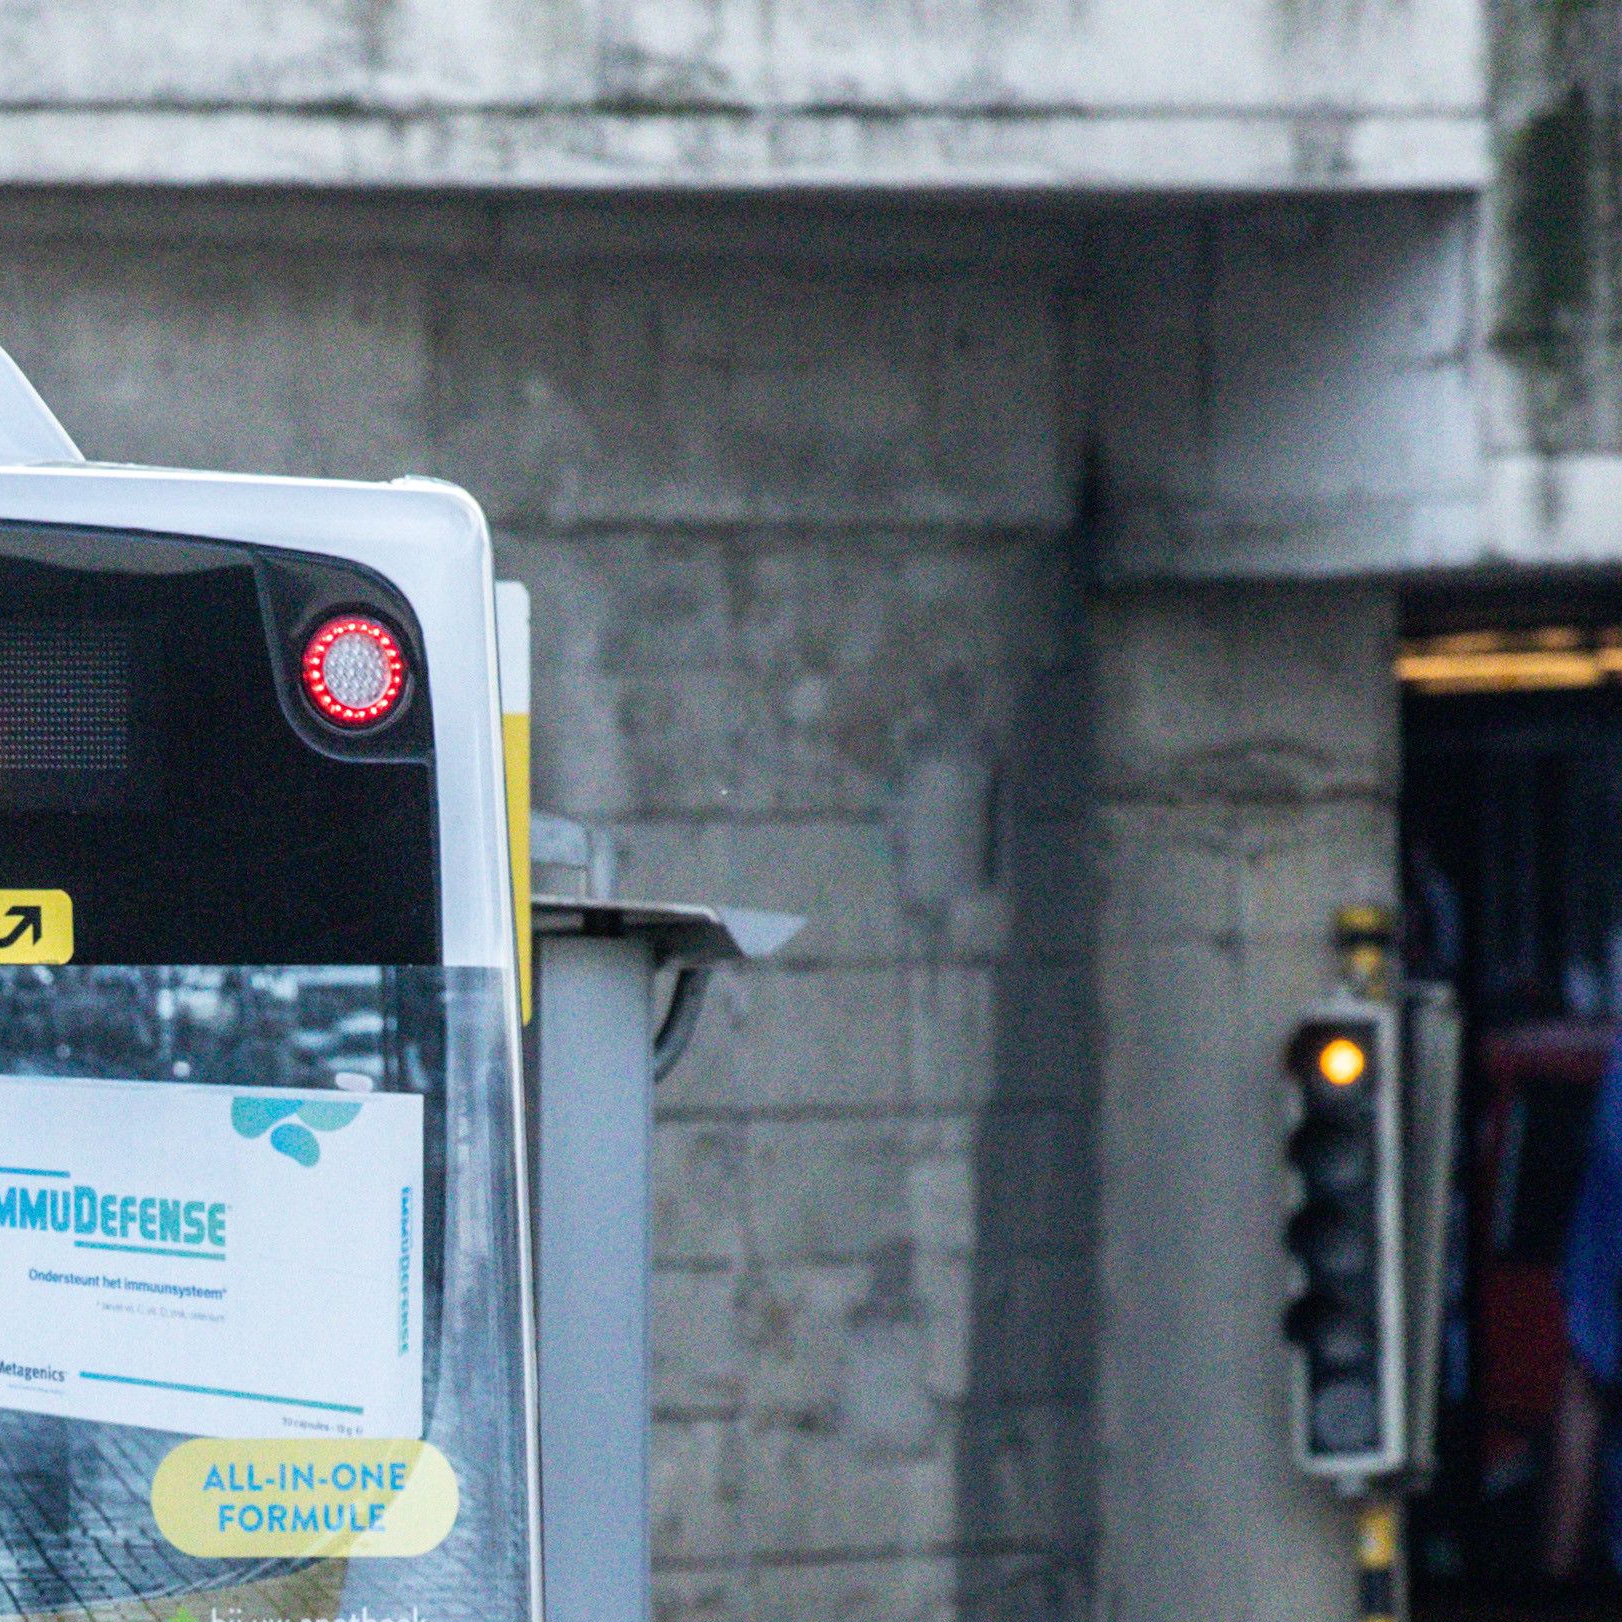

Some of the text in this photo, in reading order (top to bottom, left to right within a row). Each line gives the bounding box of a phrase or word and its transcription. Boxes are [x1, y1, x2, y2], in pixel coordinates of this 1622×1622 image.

[28, 1268, 100, 1289] Ondersteunt
[102, 1277, 121, 1290] het
[202, 1462, 407, 1491] ALL-IN-ONE
[218, 1503, 386, 1533] FORMULE
